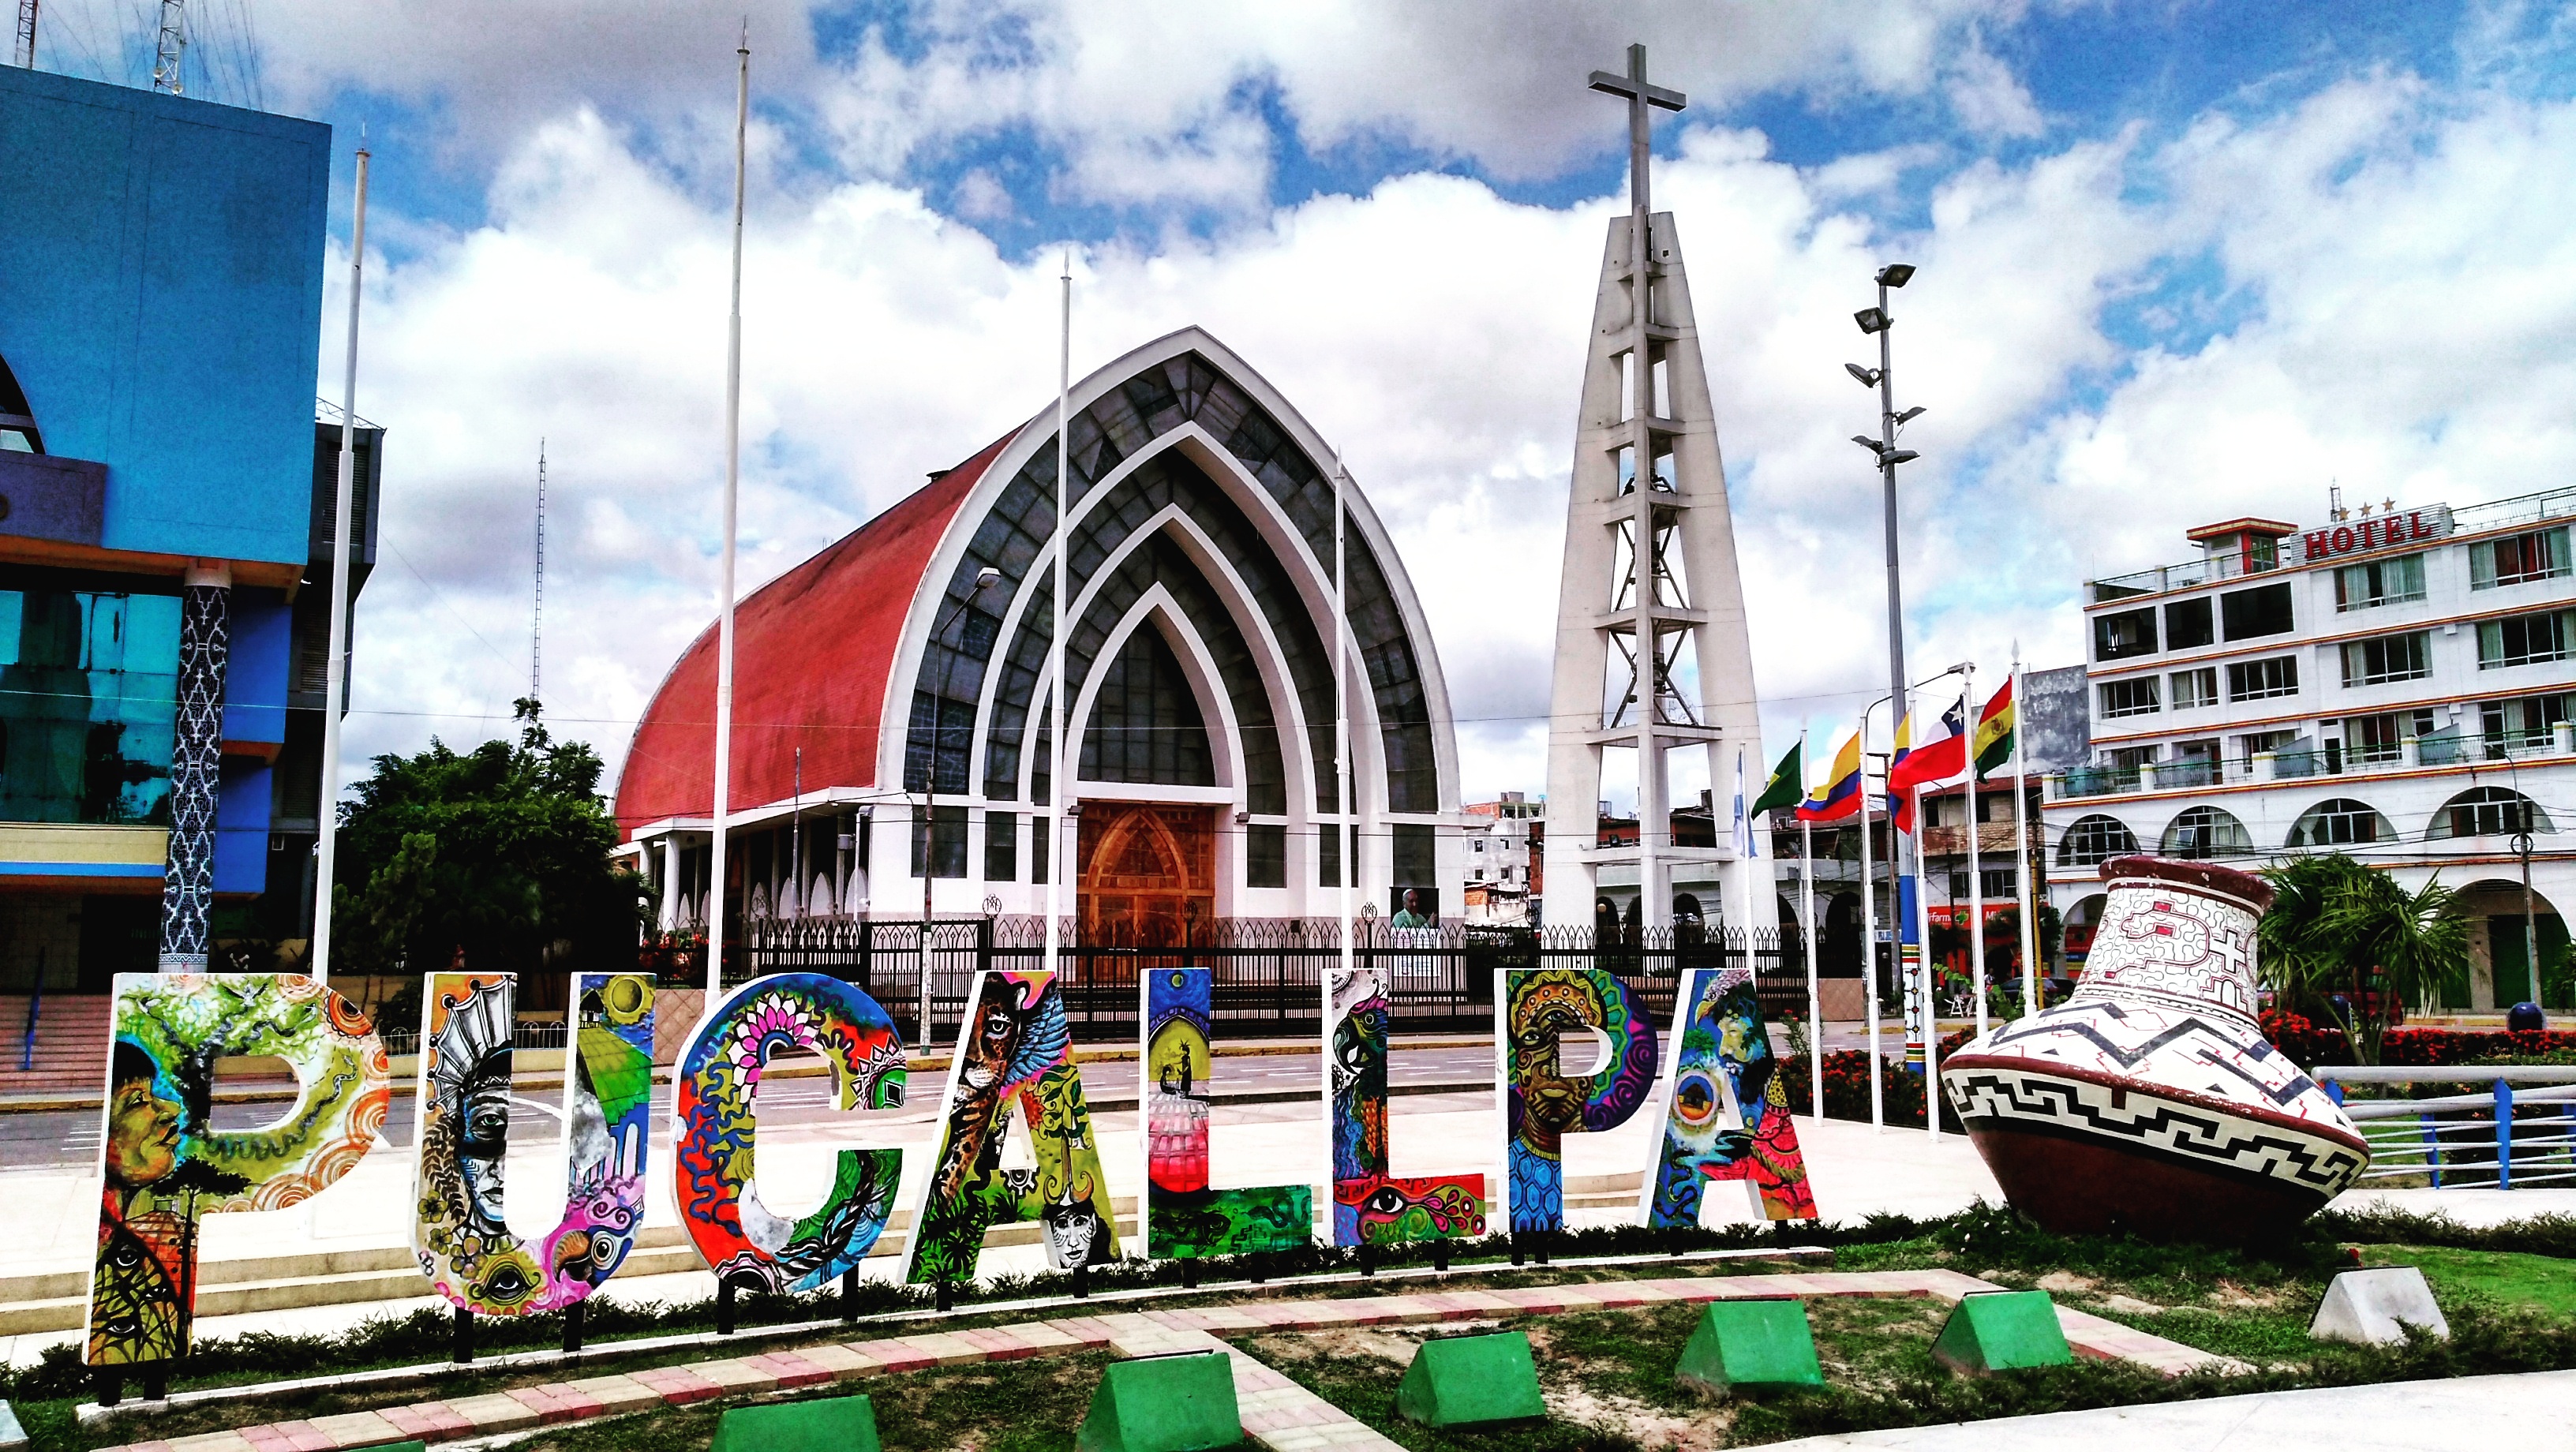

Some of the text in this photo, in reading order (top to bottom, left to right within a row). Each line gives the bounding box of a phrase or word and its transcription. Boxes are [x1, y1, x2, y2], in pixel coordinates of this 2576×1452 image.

[2303, 511, 2432, 559] HOTEL
[1927, 911, 1952, 922] ifarm
[82, 968, 1818, 1366] PUCALLPA
